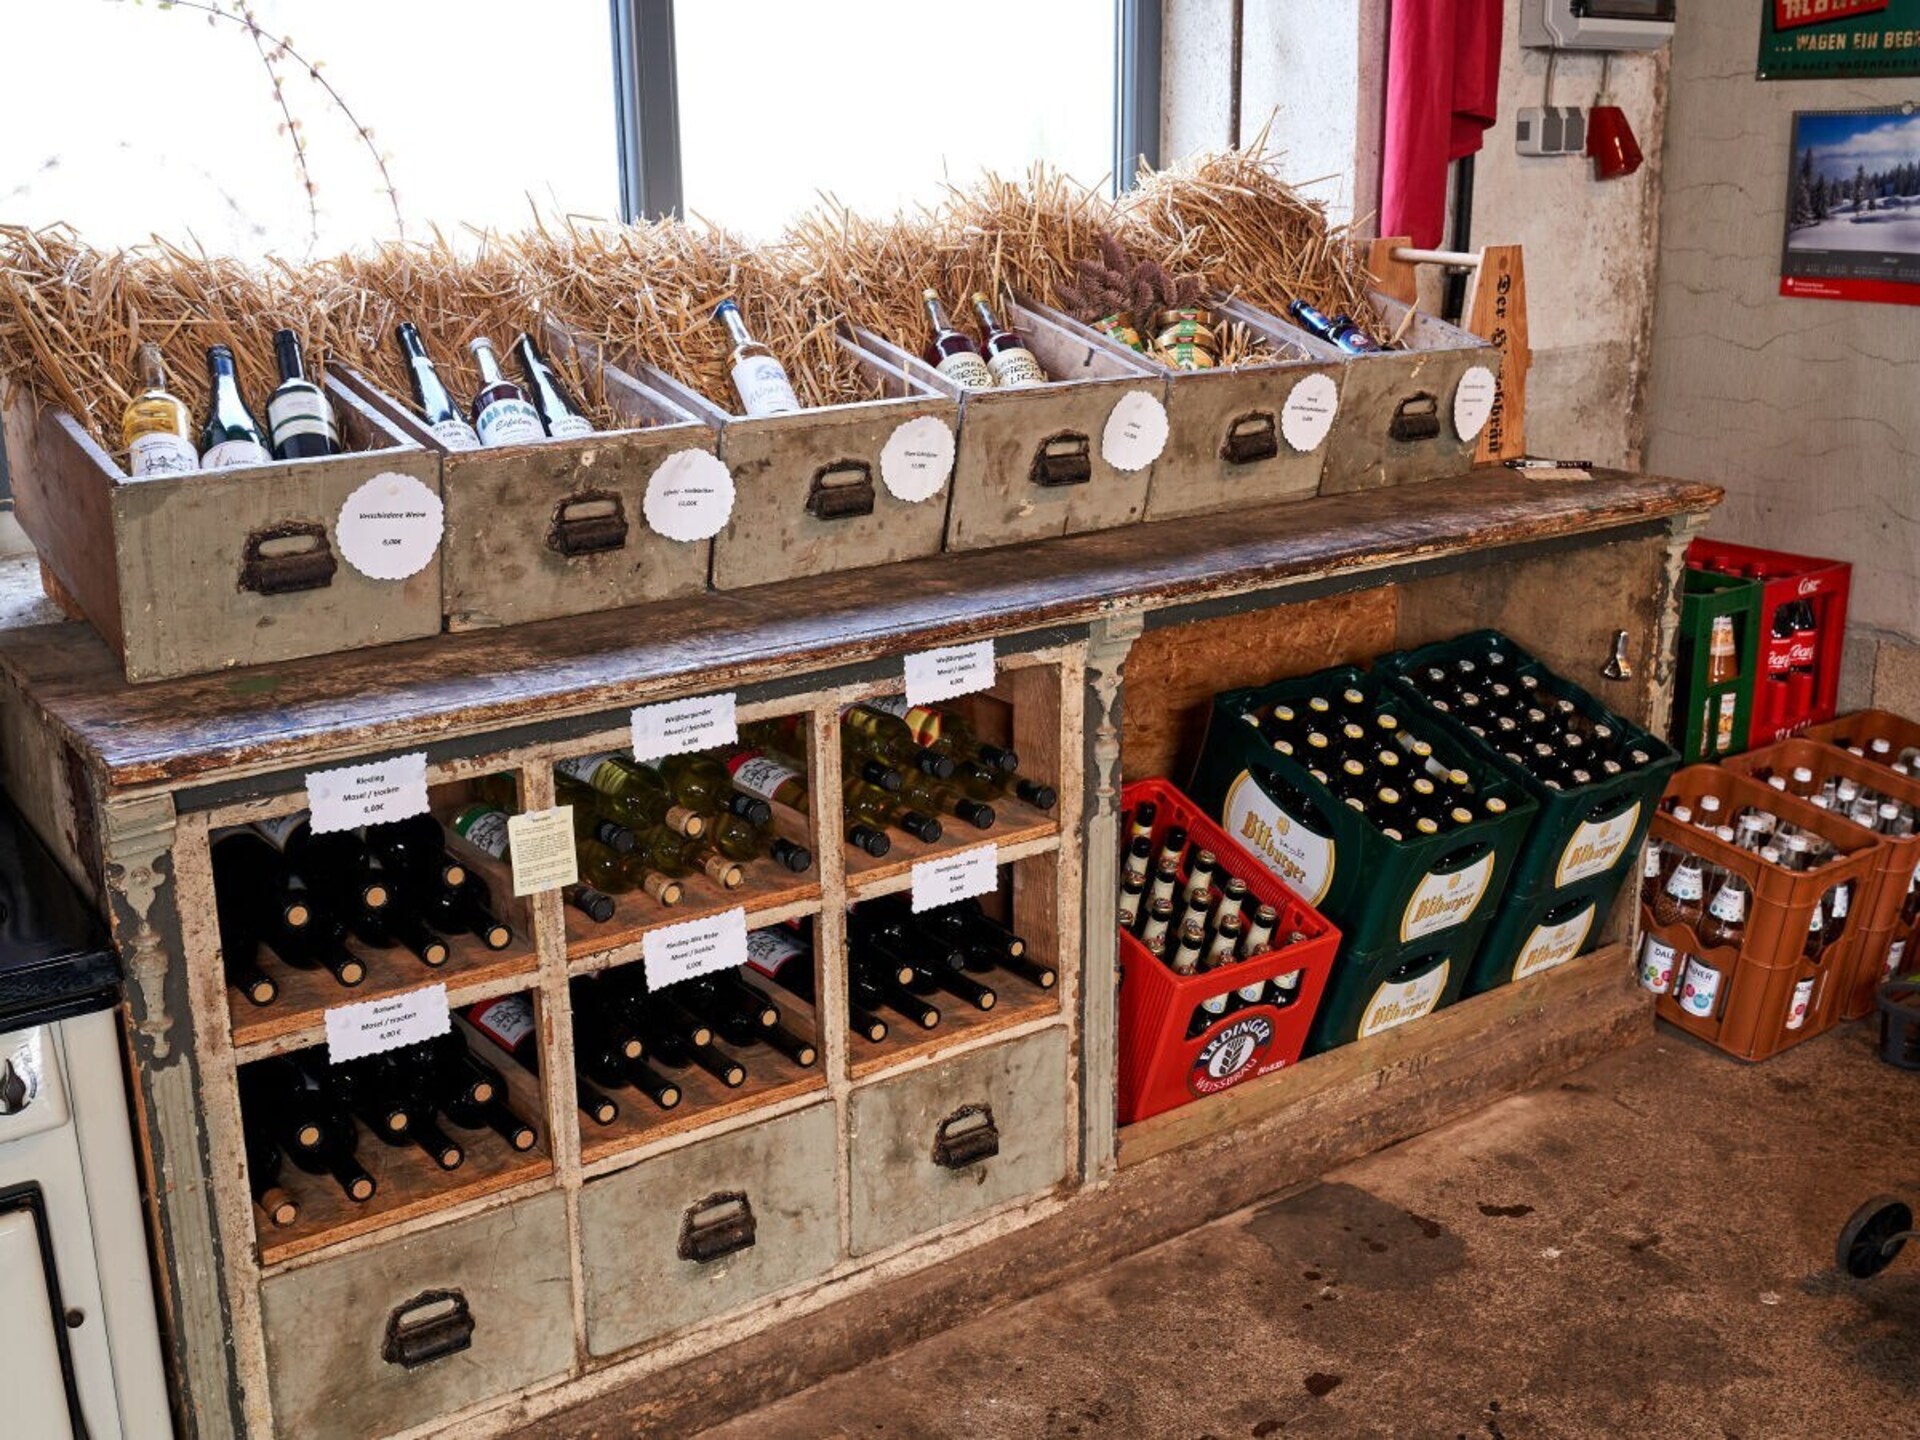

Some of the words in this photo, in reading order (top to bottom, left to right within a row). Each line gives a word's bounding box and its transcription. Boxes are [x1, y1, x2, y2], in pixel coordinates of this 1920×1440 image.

[1854, 32, 1878, 48] EIN
[1497, 273, 1511, 318] Der
[356, 775, 385, 785] Riesling
[342, 793, 366, 802] Mosel
[1241, 810, 1306, 884] Bitburger
[1411, 892, 1474, 924] Bitburger
[361, 1020, 383, 1031] Mosel
[390, 1012, 417, 1024] trocken
[1199, 1018, 1270, 1060] ERDINGER
